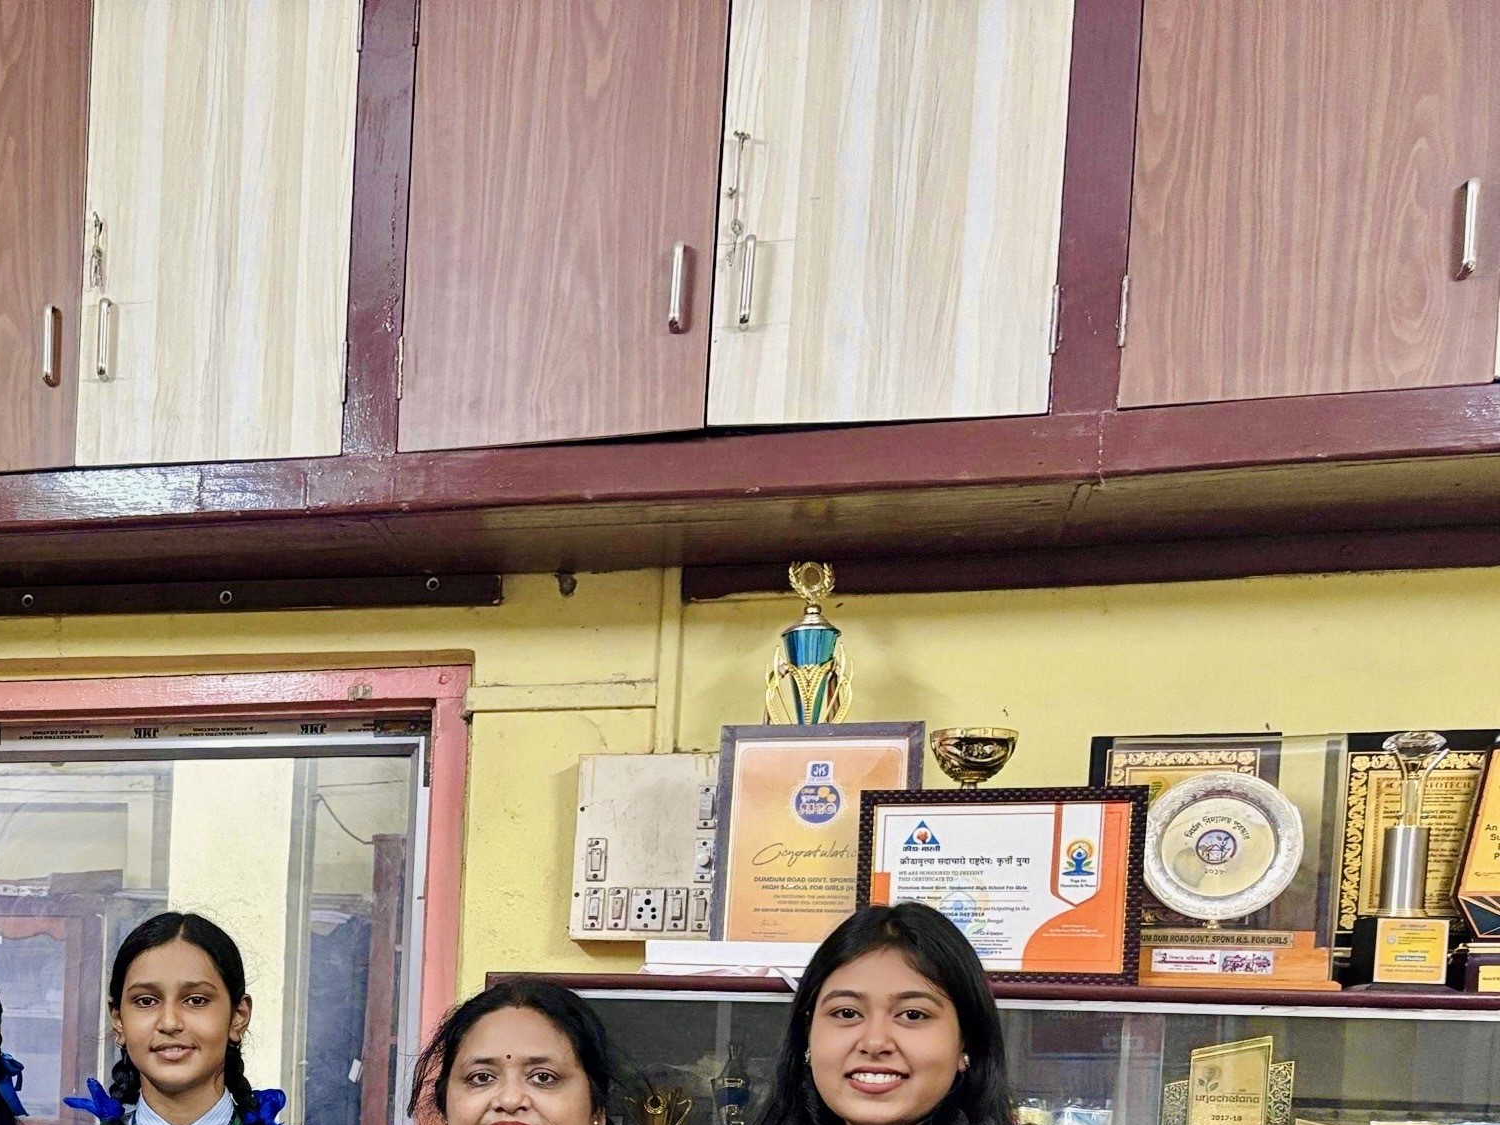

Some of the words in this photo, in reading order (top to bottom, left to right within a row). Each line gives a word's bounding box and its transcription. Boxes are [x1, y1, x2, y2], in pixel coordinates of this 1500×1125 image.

[133, 727, 159, 739] JMK
[300, 723, 327, 735] JMK
[1153, 935, 1169, 943] DUM
[1170, 935, 1189, 943] ROAD
[1190, 935, 1209, 943] GOVT.
[1212, 935, 1235, 944] SPONS
[1236, 936, 1250, 944] H.S.
[1251, 936, 1266, 944] FOR
[1267, 936, 1288, 945] GIRLS
[1211, 1114, 1242, 1122] 2017-18
